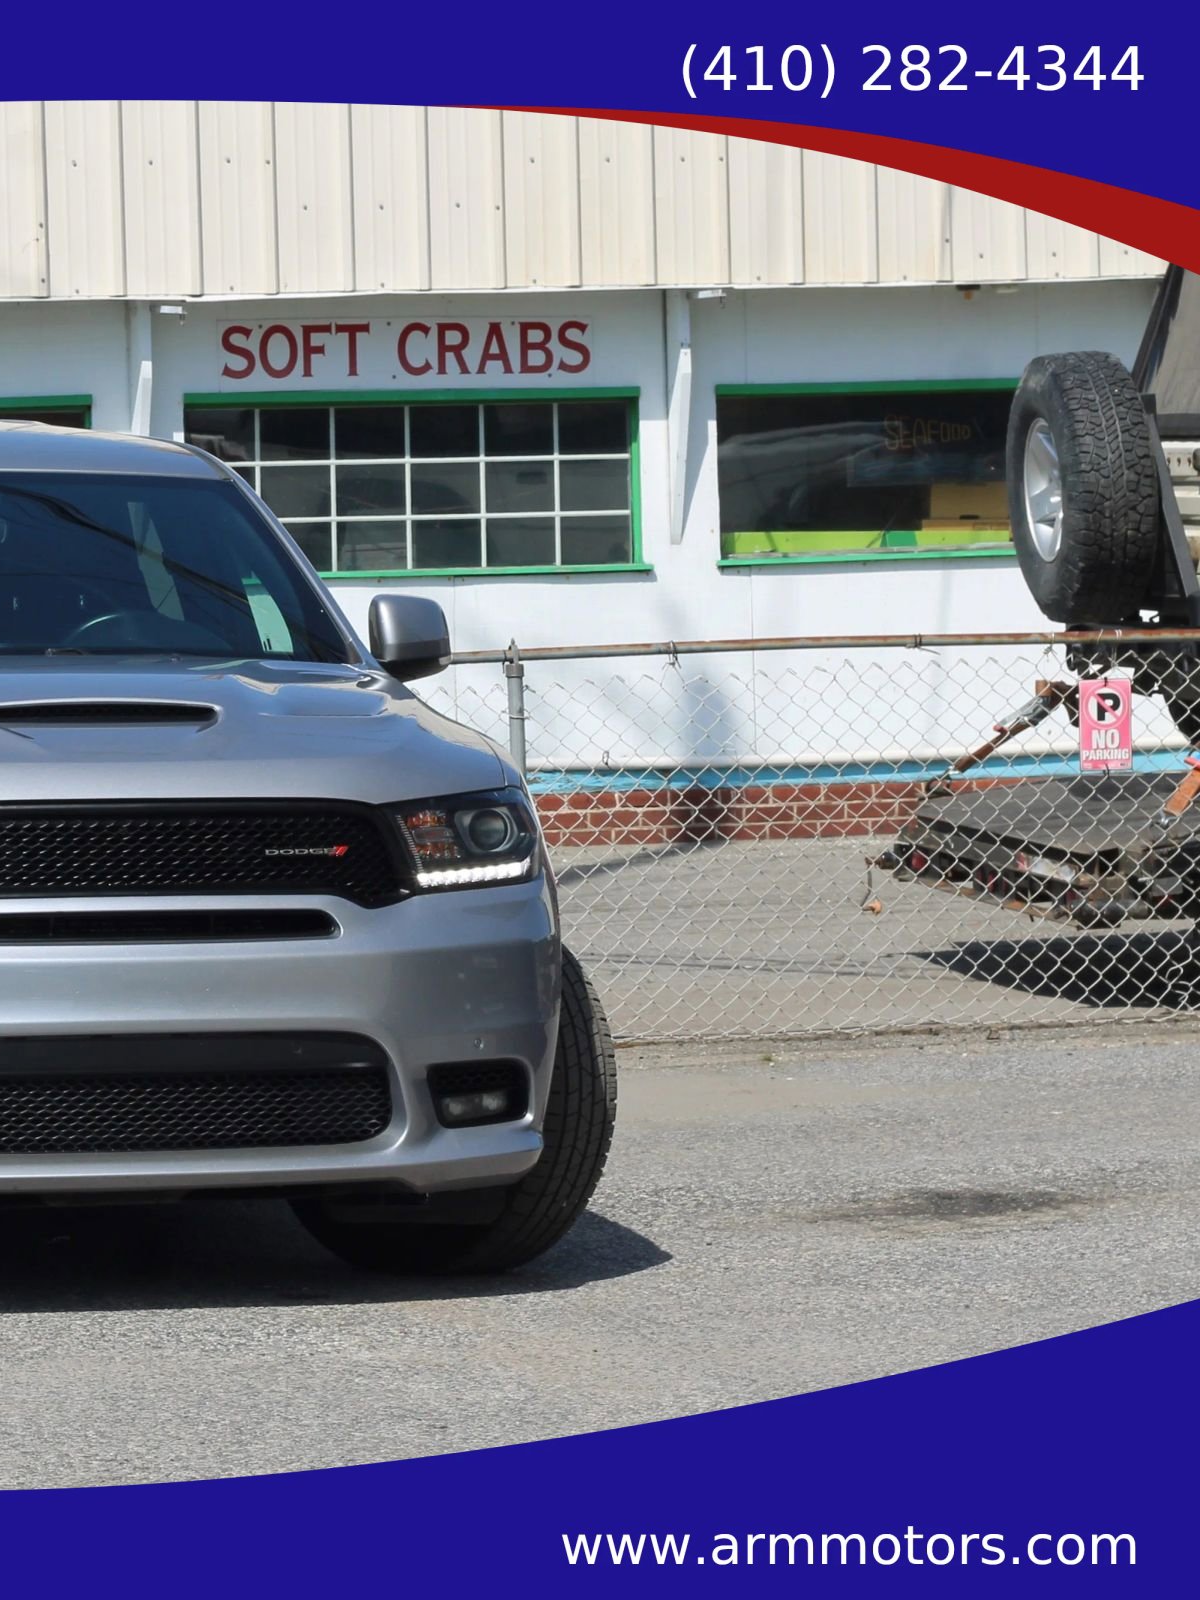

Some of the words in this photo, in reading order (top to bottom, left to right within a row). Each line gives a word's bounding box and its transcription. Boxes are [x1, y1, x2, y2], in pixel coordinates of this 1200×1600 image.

[221, 322, 370, 380] SOFT
[397, 320, 591, 376] CRABS
[1091, 728, 1120, 749] NO
[1082, 748, 1130, 761] PARKING
[265, 846, 337, 857] DODGE
